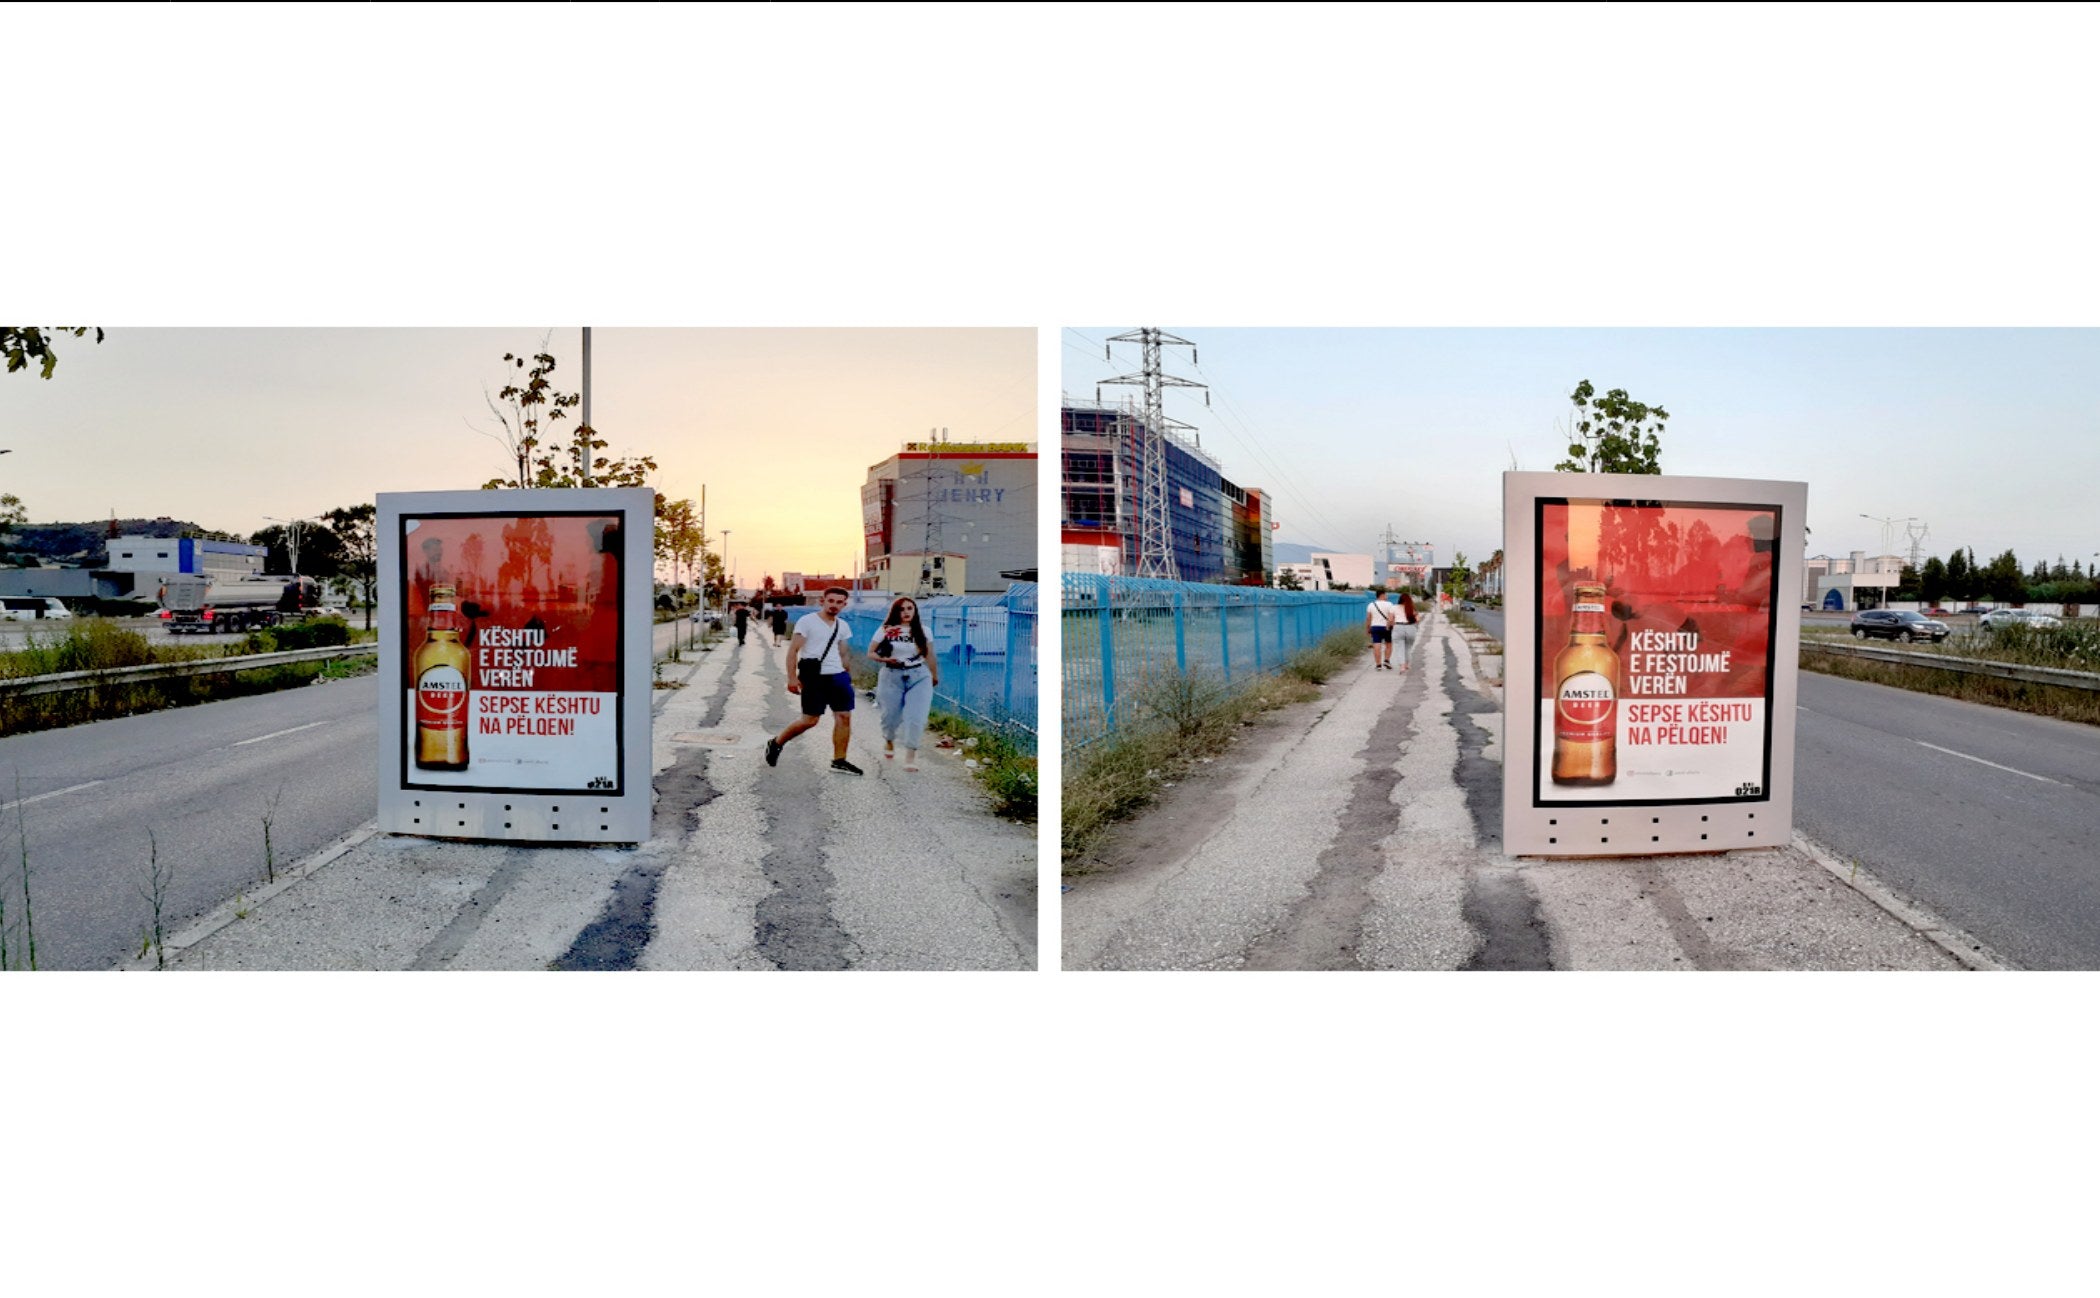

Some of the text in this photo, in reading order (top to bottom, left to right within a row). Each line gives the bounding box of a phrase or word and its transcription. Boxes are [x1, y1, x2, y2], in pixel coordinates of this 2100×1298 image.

[479, 626, 545, 647] KËSHTU
[1631, 629, 1698, 651] KËSHTU
[479, 647, 578, 667] E FESTOJMË
[1630, 651, 1731, 673] E FESTOJMË
[480, 666, 534, 688] VERËN
[1630, 672, 1687, 694] VERËN
[479, 693, 601, 715] SEPSE KËSHTU
[1562, 690, 1610, 699] AMSTEL
[1628, 701, 1752, 723] SEPSE KËSHTU
[479, 714, 575, 736] NA PËLQEN!
[1628, 723, 1728, 745] NA PËLQEN!
